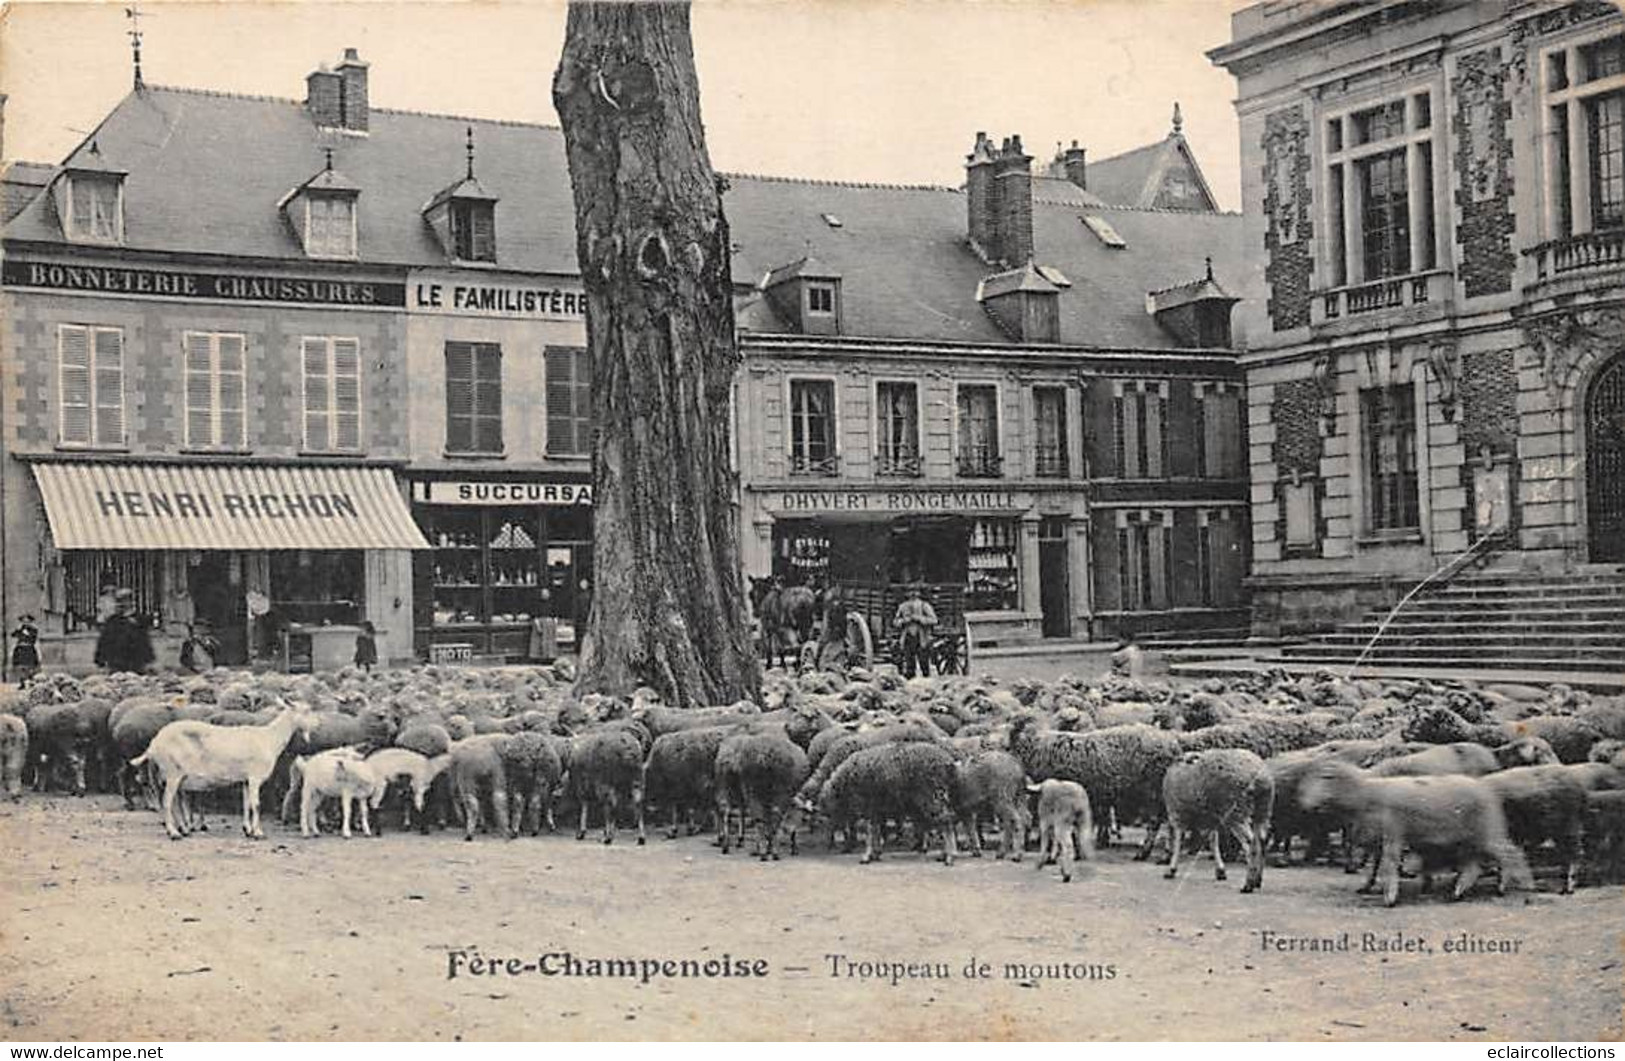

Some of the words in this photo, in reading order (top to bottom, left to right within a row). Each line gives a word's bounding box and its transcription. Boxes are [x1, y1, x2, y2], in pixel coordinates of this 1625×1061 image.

[30, 264, 198, 296] BONNETERIE
[214, 276, 376, 303] CHAUSSURES
[417, 284, 442, 307] LE
[96, 490, 212, 518] HENRI
[225, 492, 358, 518] RICHON
[783, 492, 868, 509] DHYVERT
[888, 493, 1017, 510] RONGEMAILLE
